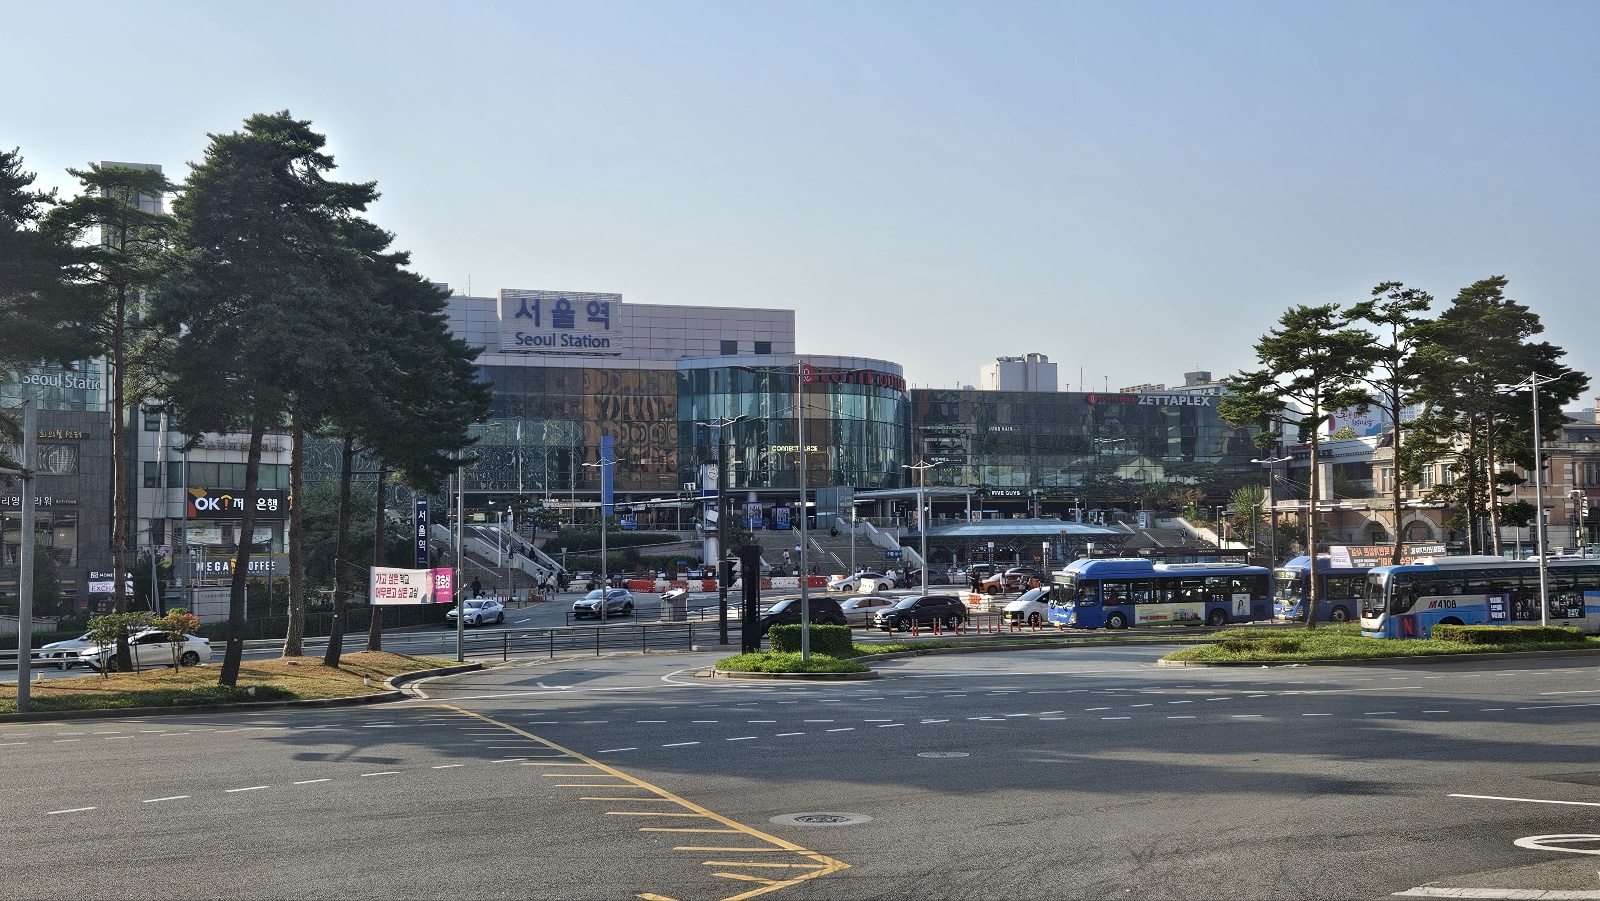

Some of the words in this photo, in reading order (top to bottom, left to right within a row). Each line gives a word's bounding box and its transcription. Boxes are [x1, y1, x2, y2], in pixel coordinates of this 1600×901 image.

[515, 298, 610, 330] 서울역
[515, 332, 556, 347] Seoul
[560, 334, 610, 348] Station
[1138, 395, 1211, 407] ZETTAPLEX
[233, 498, 278, 511] 저은행
[418, 510, 426, 551] 서울역
[248, 561, 276, 571] OFFEE
[1211, 594, 1224, 602] 752
